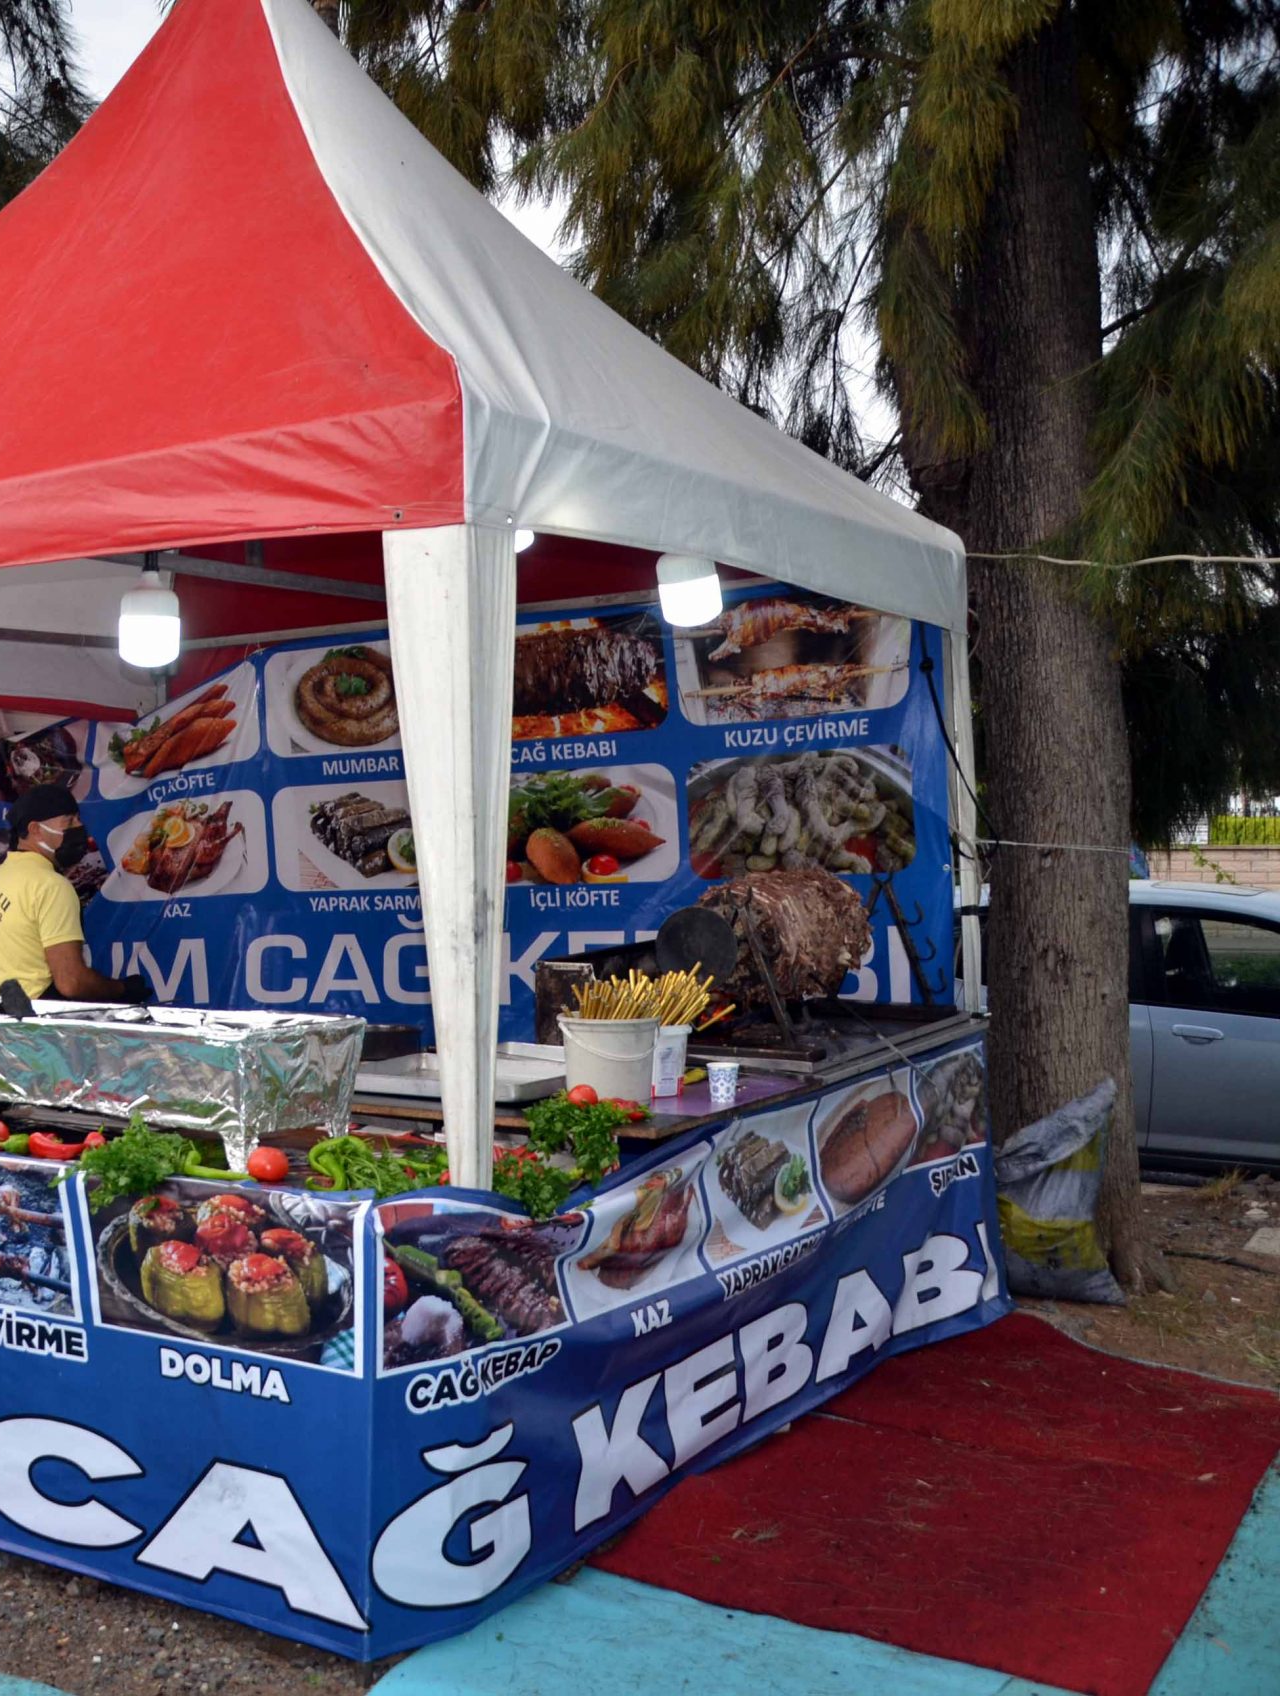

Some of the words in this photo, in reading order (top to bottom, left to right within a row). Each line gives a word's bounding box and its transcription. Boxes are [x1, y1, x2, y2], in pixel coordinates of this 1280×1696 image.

[724, 727, 779, 749] KUZU
[783, 716, 871, 746] ÇEVİRME
[322, 756, 400, 776] MUMBAR
[510, 741, 546, 764] CAĞ
[551, 739, 617, 760] KEBABI
[163, 902, 193, 919] KAZ
[309, 895, 371, 912] YAPRAK
[529, 888, 560, 911] İÇLİ
[565, 888, 621, 908] KÖFTE
[245, 914, 432, 1005] CAĞ
[717, 1249, 782, 1301] YAPRAK
[630, 1299, 673, 1338] KAZ
[159, 1347, 292, 1404] DOLMA
[406, 1358, 480, 1414] CAĞ
[477, 1338, 564, 1393] KEBAP
[571, 1220, 999, 1533] KEBABI
